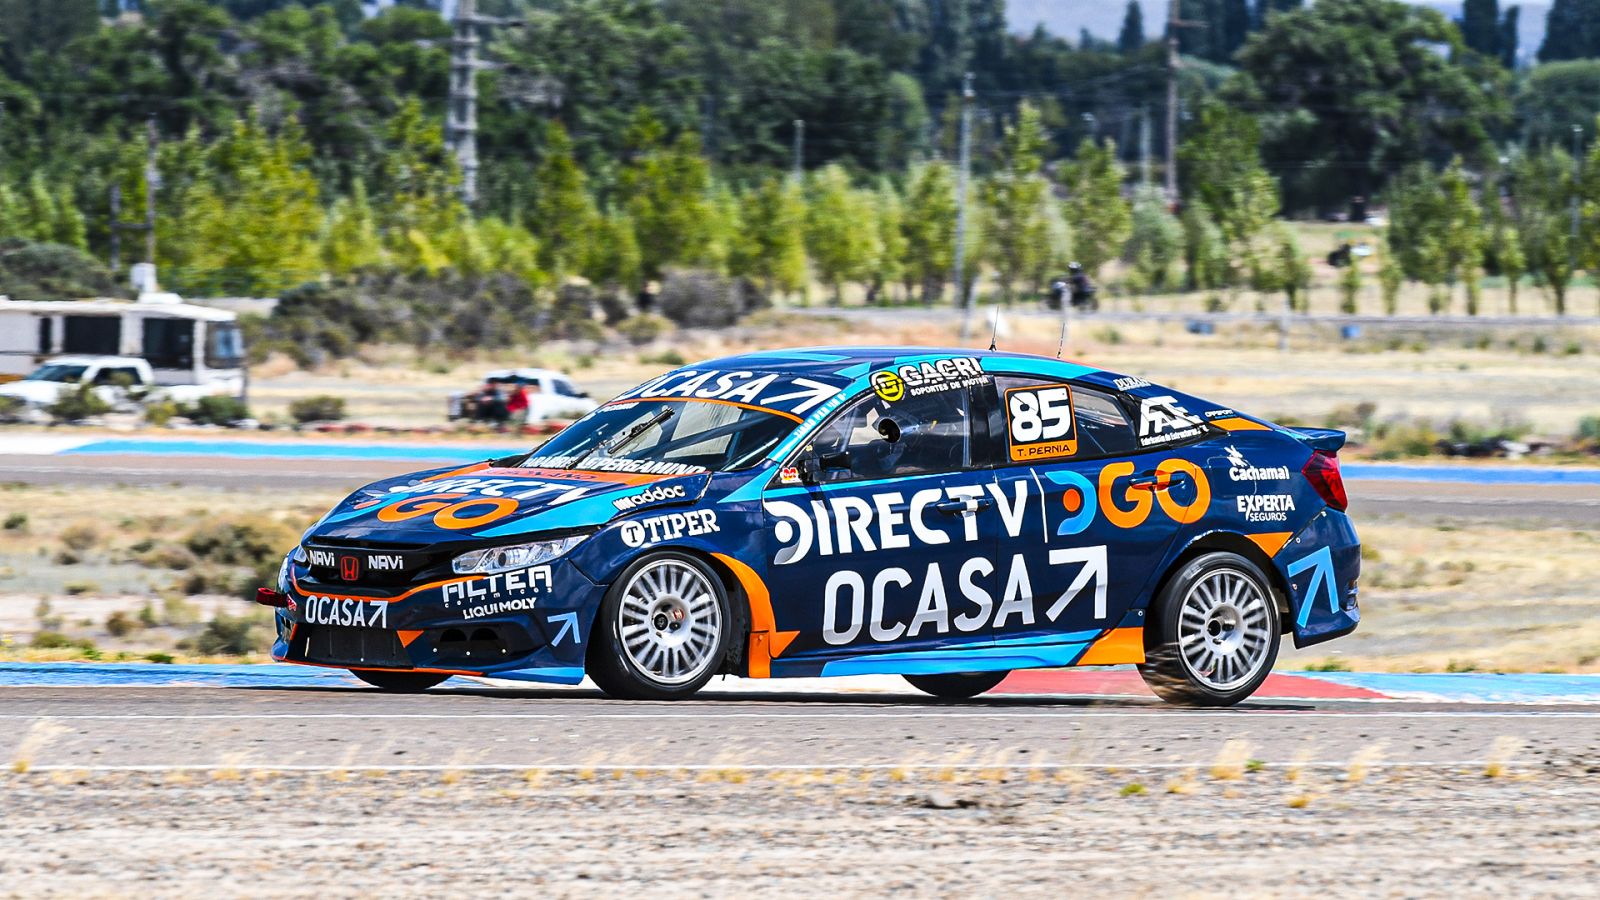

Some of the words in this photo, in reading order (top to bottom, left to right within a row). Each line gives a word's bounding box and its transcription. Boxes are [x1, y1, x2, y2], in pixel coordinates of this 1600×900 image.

[911, 383, 949, 396] SOPORTES
[951, 379, 961, 389] DE
[1009, 387, 1071, 442] 85
[1017, 448, 1028, 457] T.
[1028, 444, 1071, 456] PERNIA
[1236, 494, 1295, 520] EXPERTA
[1249, 512, 1287, 521] SEGUROS
[642, 508, 720, 543] TIPER
[305, 594, 367, 628] OCASA
[823, 553, 1036, 646] OCASA
